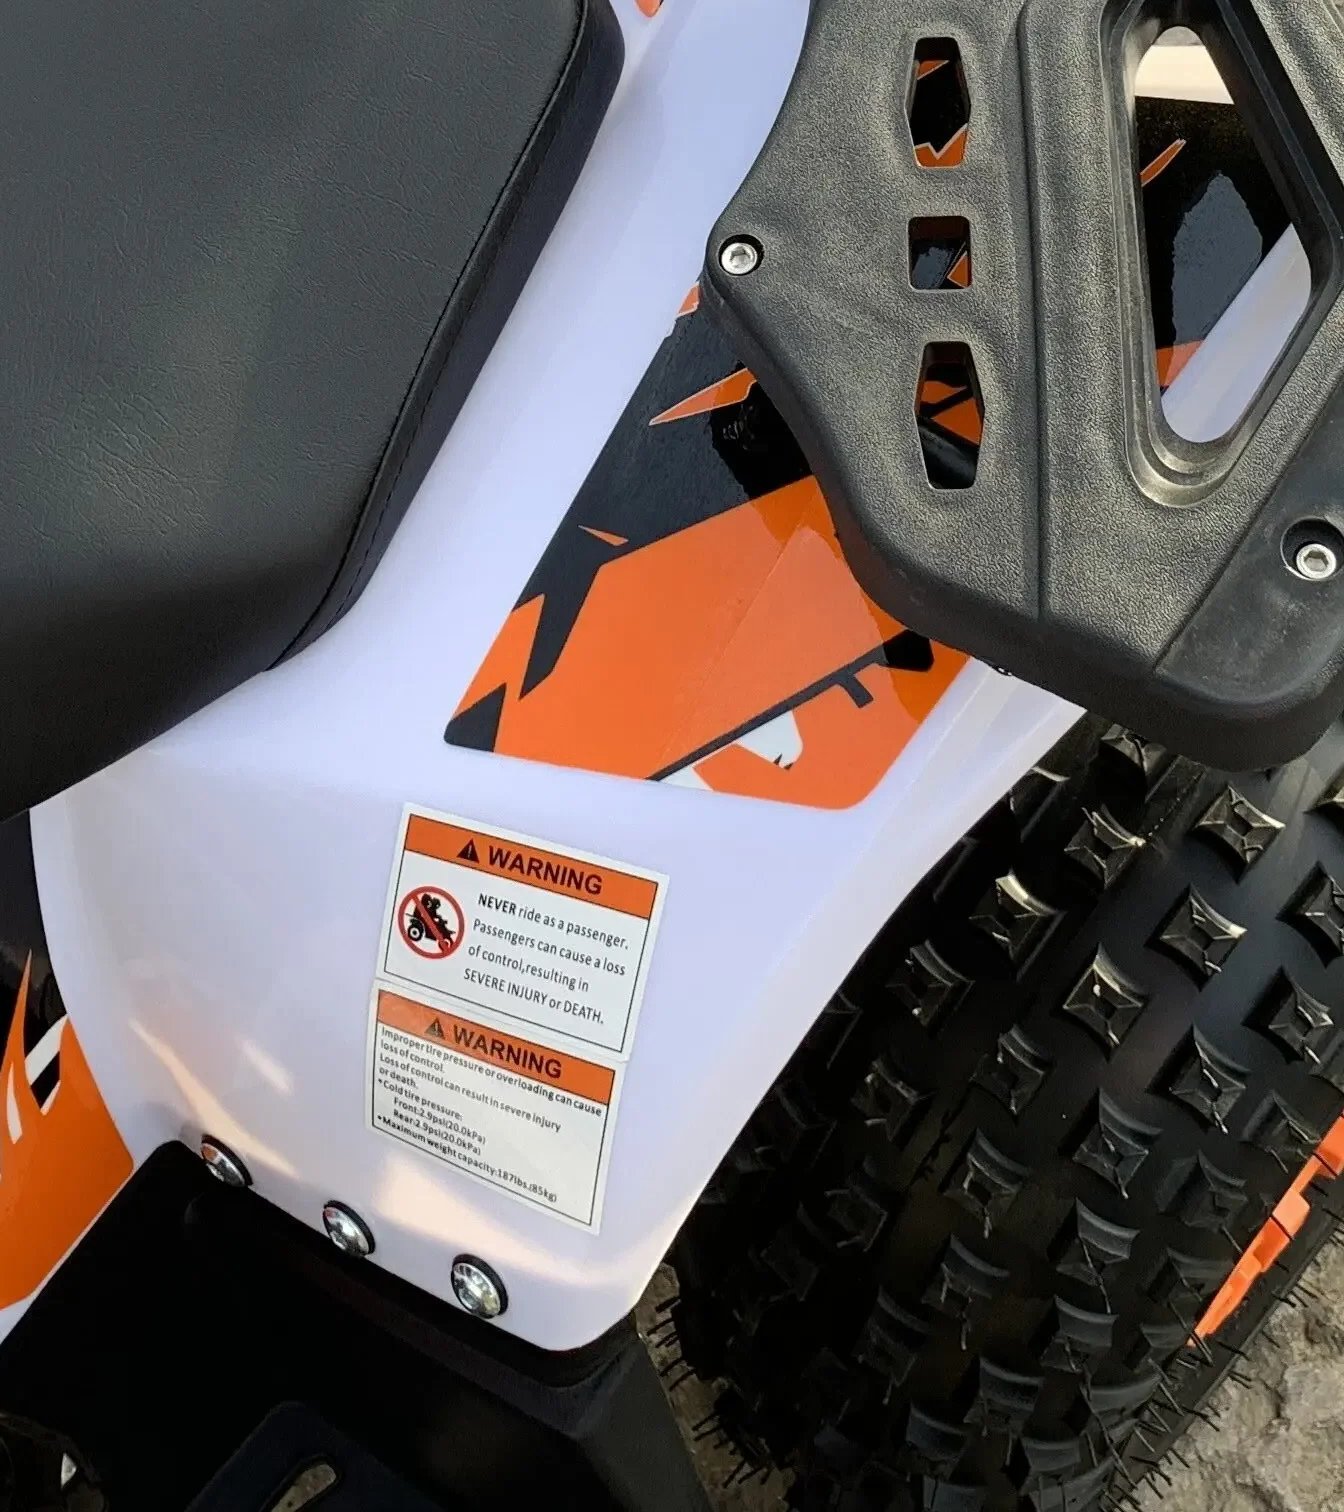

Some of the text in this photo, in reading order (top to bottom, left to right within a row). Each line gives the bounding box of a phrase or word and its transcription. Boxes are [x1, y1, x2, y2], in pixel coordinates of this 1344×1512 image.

[489, 845, 603, 895] WARNING
[473, 918, 626, 976] Passengers can cause a loss
[478, 893, 629, 949] NEVER ride as a passenger.
[468, 945, 481, 957] of
[578, 976, 589, 992] in
[464, 968, 604, 1025] SEVERE INJURY or DEATH.
[379, 1067, 389, 1076] or
[381, 1039, 398, 1053] loss
[399, 1048, 409, 1058] of
[381, 1026, 602, 1117] Improper tire pressure or overloading can cause
[453, 1024, 562, 1079] WARNING
[380, 1053, 561, 1133] Loss of control can result in severe injury
[404, 1089, 420, 1103] tire
[421, 1099, 463, 1121] pressure:
[427, 1138, 457, 1158] weight
